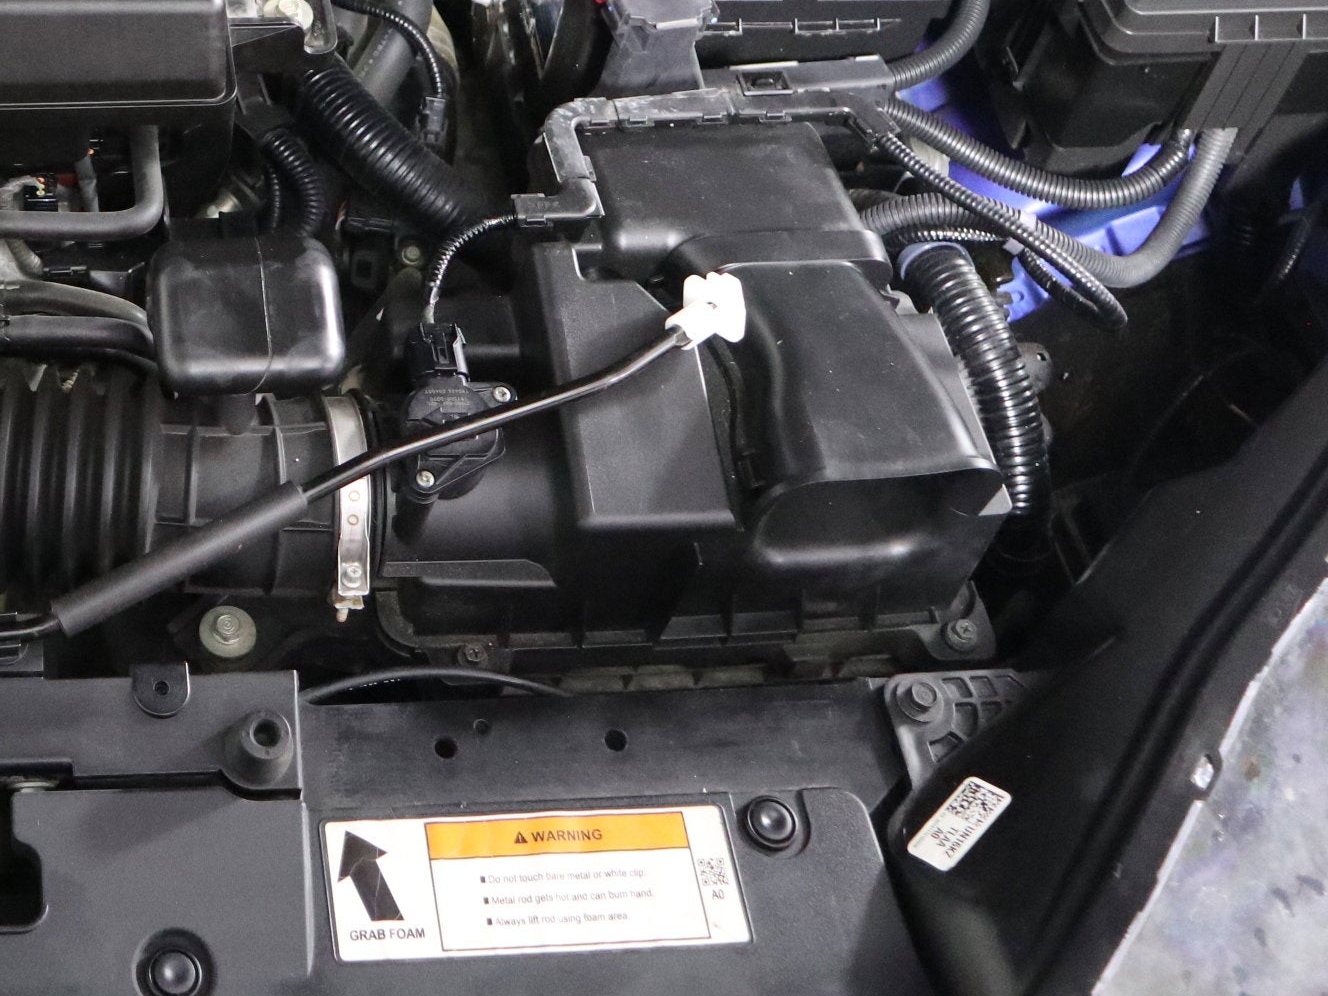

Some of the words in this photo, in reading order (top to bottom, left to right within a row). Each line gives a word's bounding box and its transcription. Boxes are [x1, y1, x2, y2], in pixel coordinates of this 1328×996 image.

[531, 828, 603, 843] WARNING
[488, 874, 501, 884] Do
[503, 874, 517, 883] not
[519, 871, 544, 883] touch
[545, 871, 565, 881] bare
[567, 870, 591, 880] metal
[593, 871, 602, 879] or
[603, 868, 628, 879] white
[491, 894, 516, 905] Metal
[518, 895, 533, 904] rod
[535, 893, 554, 905] gets
[555, 892, 570, 902] hot
[572, 891, 588, 901] and
[590, 891, 606, 901] can
[495, 915, 526, 928] Always
[528, 913, 539, 924] lift
[541, 914, 556, 924] rod
[558, 913, 582, 925] using
[583, 912, 606, 922] foam
[349, 928, 386, 942] GRAB
[389, 927, 426, 940] FOAM
